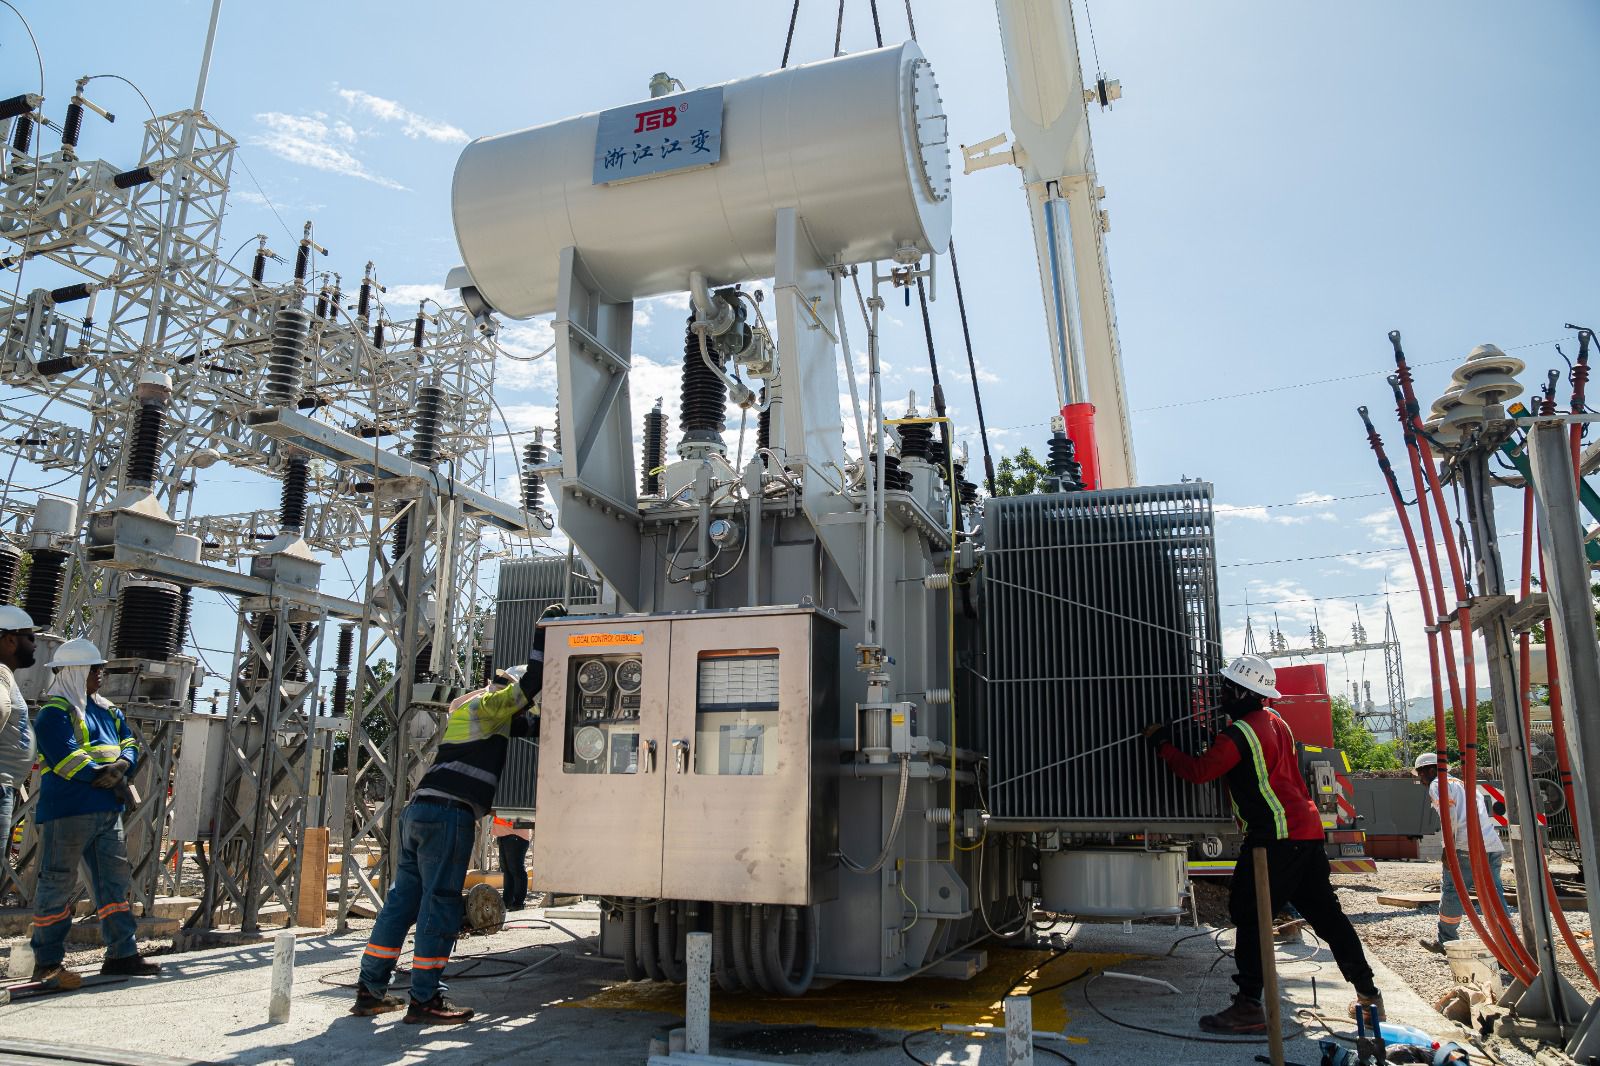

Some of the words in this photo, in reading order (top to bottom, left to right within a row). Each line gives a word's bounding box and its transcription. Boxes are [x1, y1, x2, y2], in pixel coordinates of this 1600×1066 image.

[604, 129, 711, 170] 浙江江变
[573, 636, 589, 644] LOCAL
[591, 635, 614, 643] CONTROL
[616, 634, 637, 642] CUBICLE
